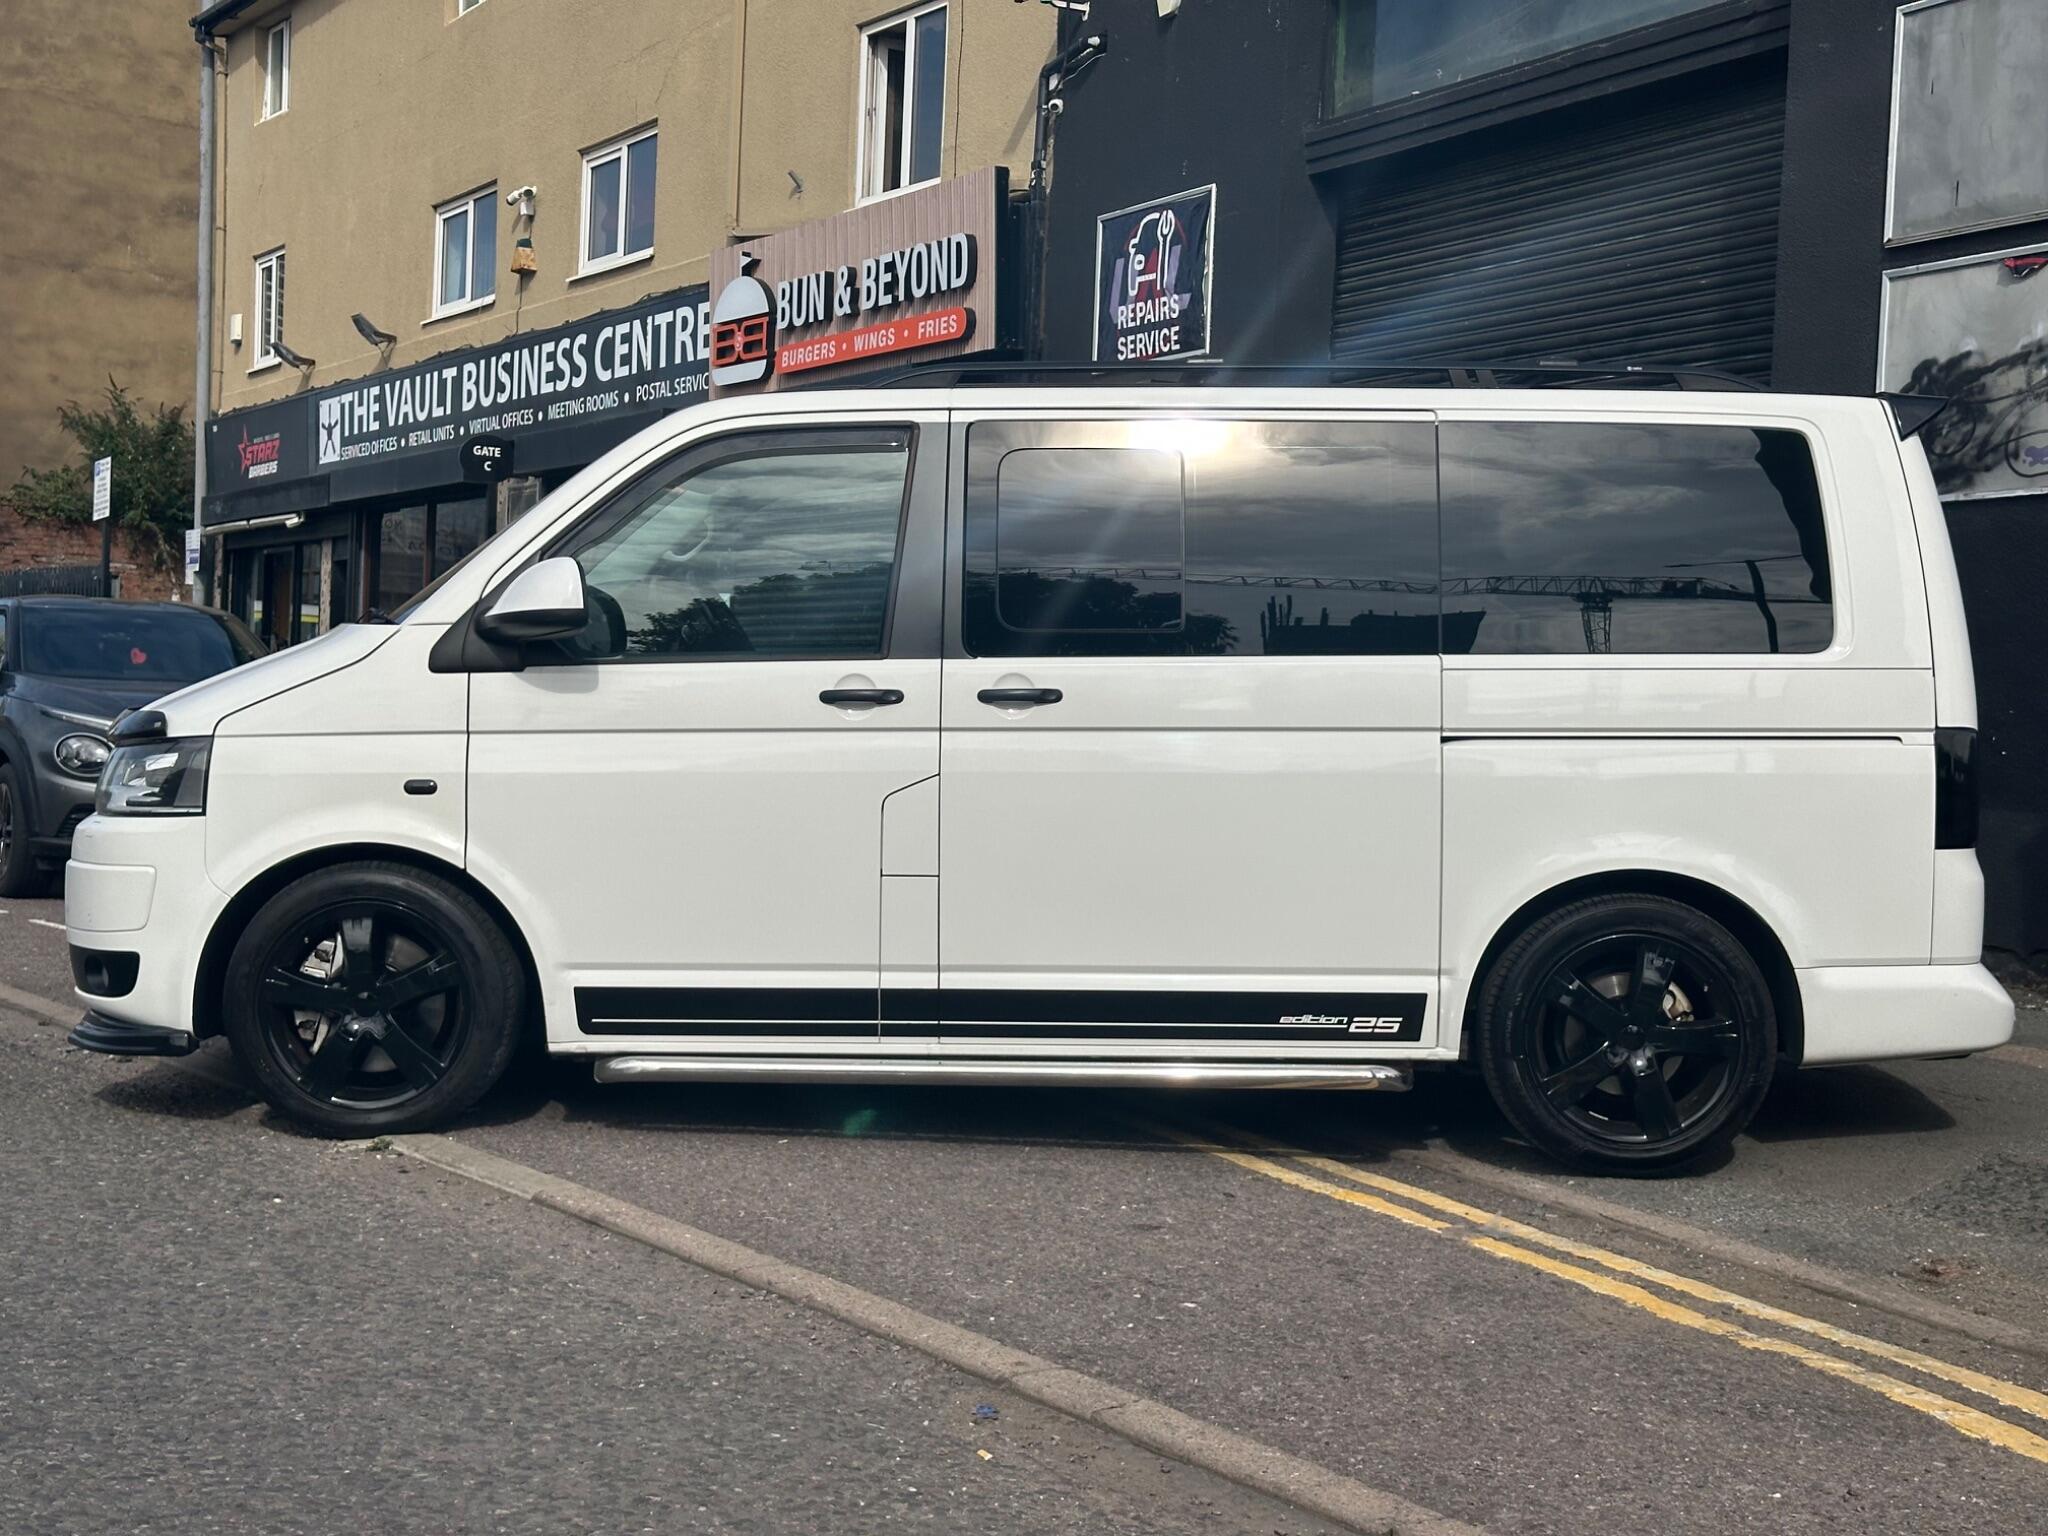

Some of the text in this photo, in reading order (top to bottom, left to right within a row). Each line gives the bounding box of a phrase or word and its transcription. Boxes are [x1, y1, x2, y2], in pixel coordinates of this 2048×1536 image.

[777, 232, 969, 330] BUN & BEYOND
[1117, 294, 1180, 330] REPAIRS
[782, 315, 957, 368] BURGERS WINGS FRIES
[1117, 326, 1181, 361] SERVICE
[341, 302, 710, 437] THE VAULT BUSINESS CENTRE
[341, 441, 371, 460] SERVICED
[371, 436, 398, 455] OFFICES
[408, 430, 433, 447] RETAIL
[433, 424, 455, 441] UNITS
[469, 416, 501, 435] VIRTUAL
[502, 409, 534, 429] OFFICES
[548, 398, 585, 421] MEETING
[586, 390, 619, 413] ROOMS
[636, 380, 672, 402] POSTAL
[245, 439, 280, 466] STARZ
[473, 446, 502, 458] GATE
[484, 461, 492, 471] C
[1279, 1014, 1403, 1033] edition 25
